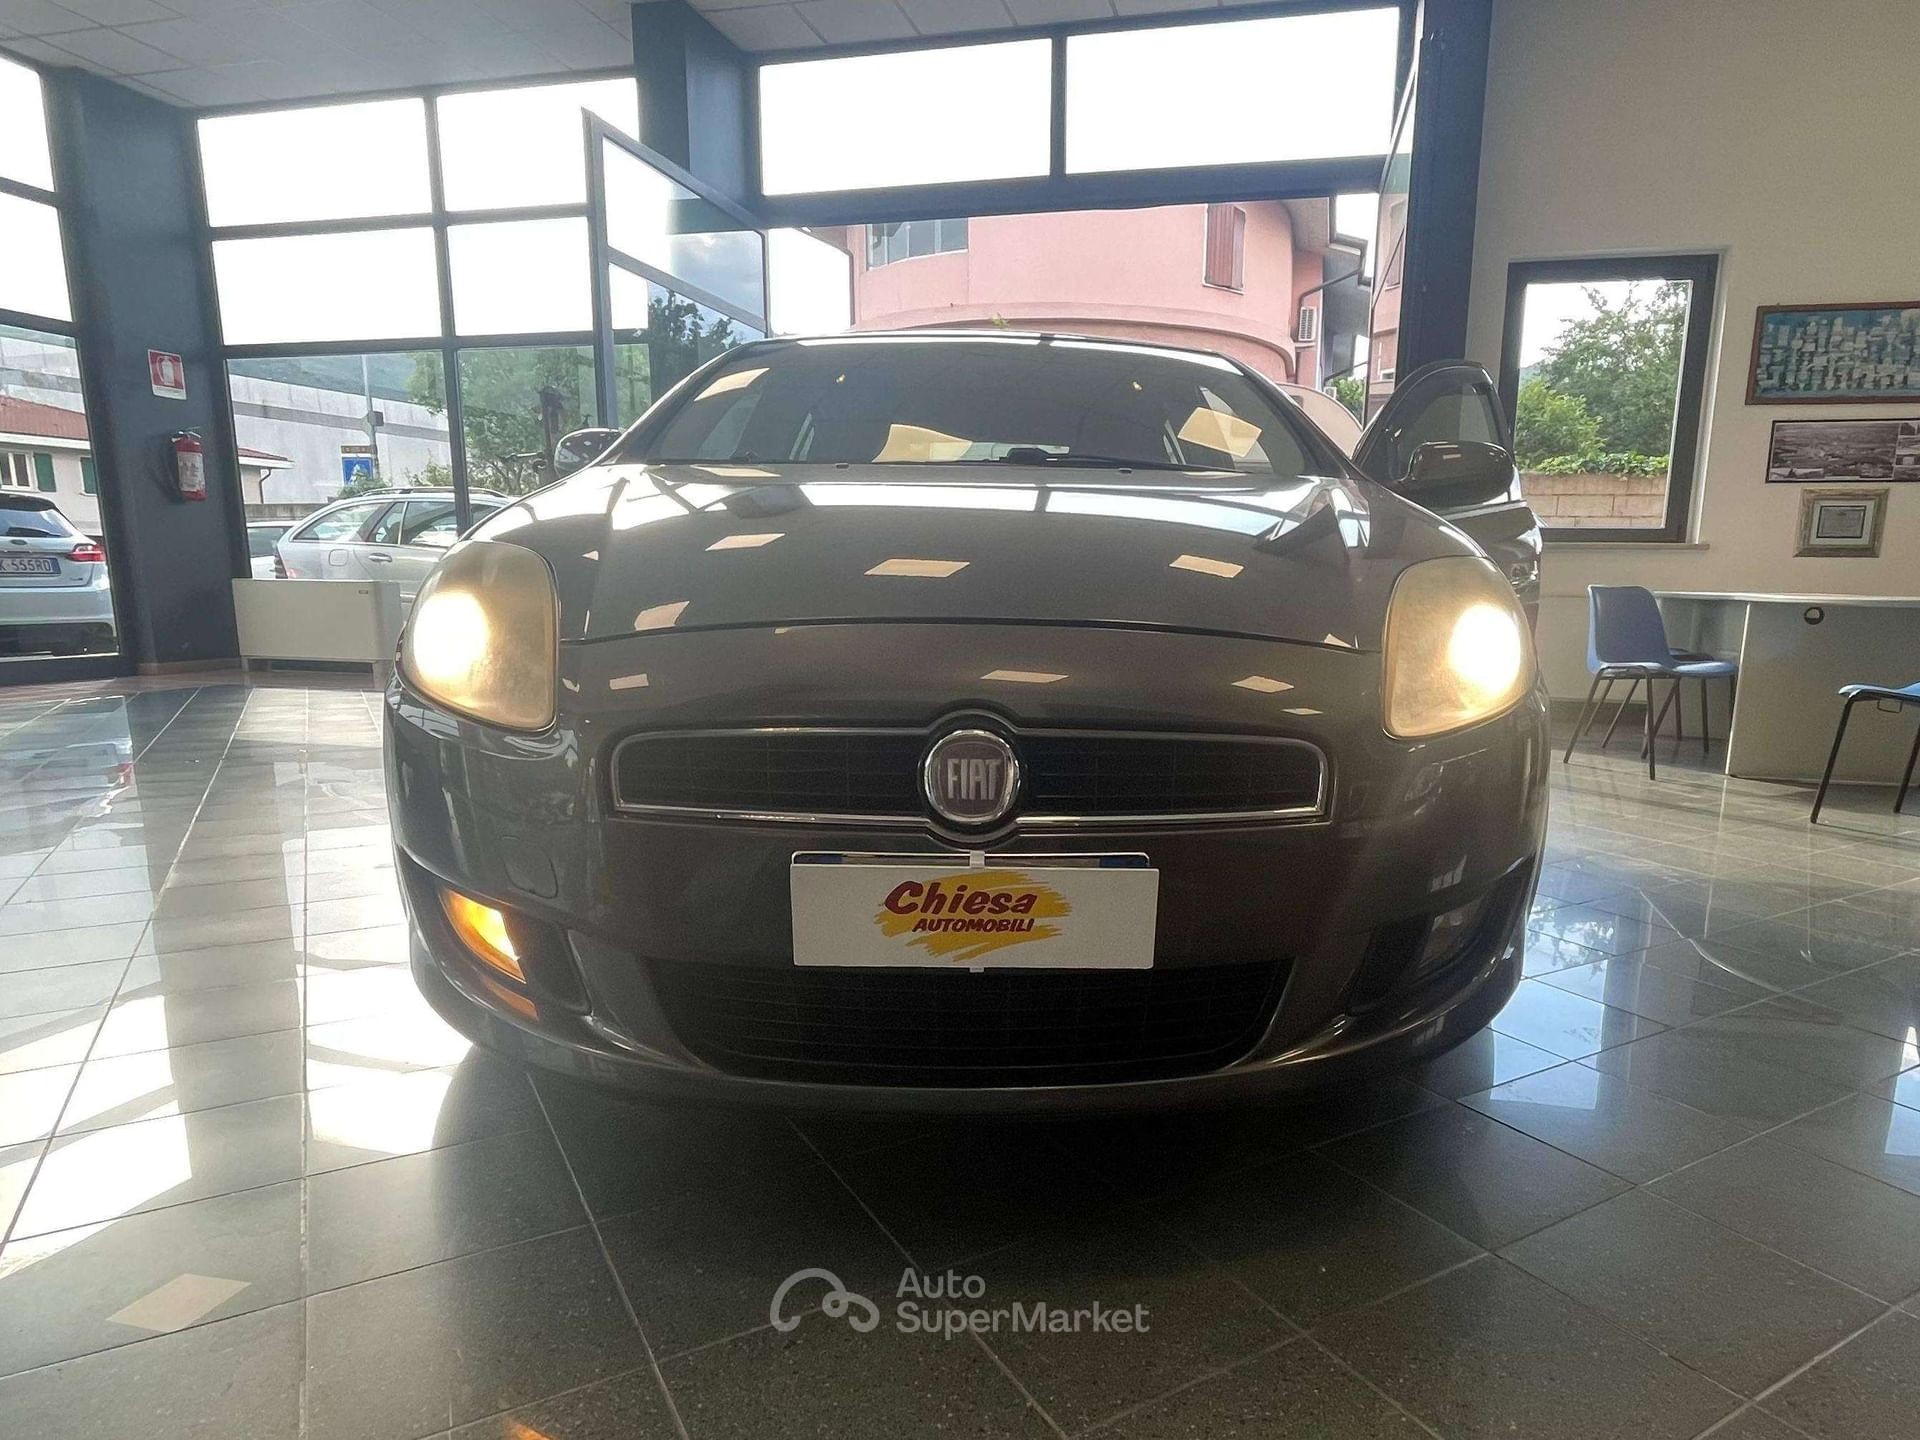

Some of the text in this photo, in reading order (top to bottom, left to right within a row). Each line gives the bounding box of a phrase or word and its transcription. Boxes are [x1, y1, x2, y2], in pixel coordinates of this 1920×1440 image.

[947, 758, 1000, 800] FIAT
[884, 880, 1038, 915] Chiesa
[912, 918, 1035, 933] AUTOMOBILI
